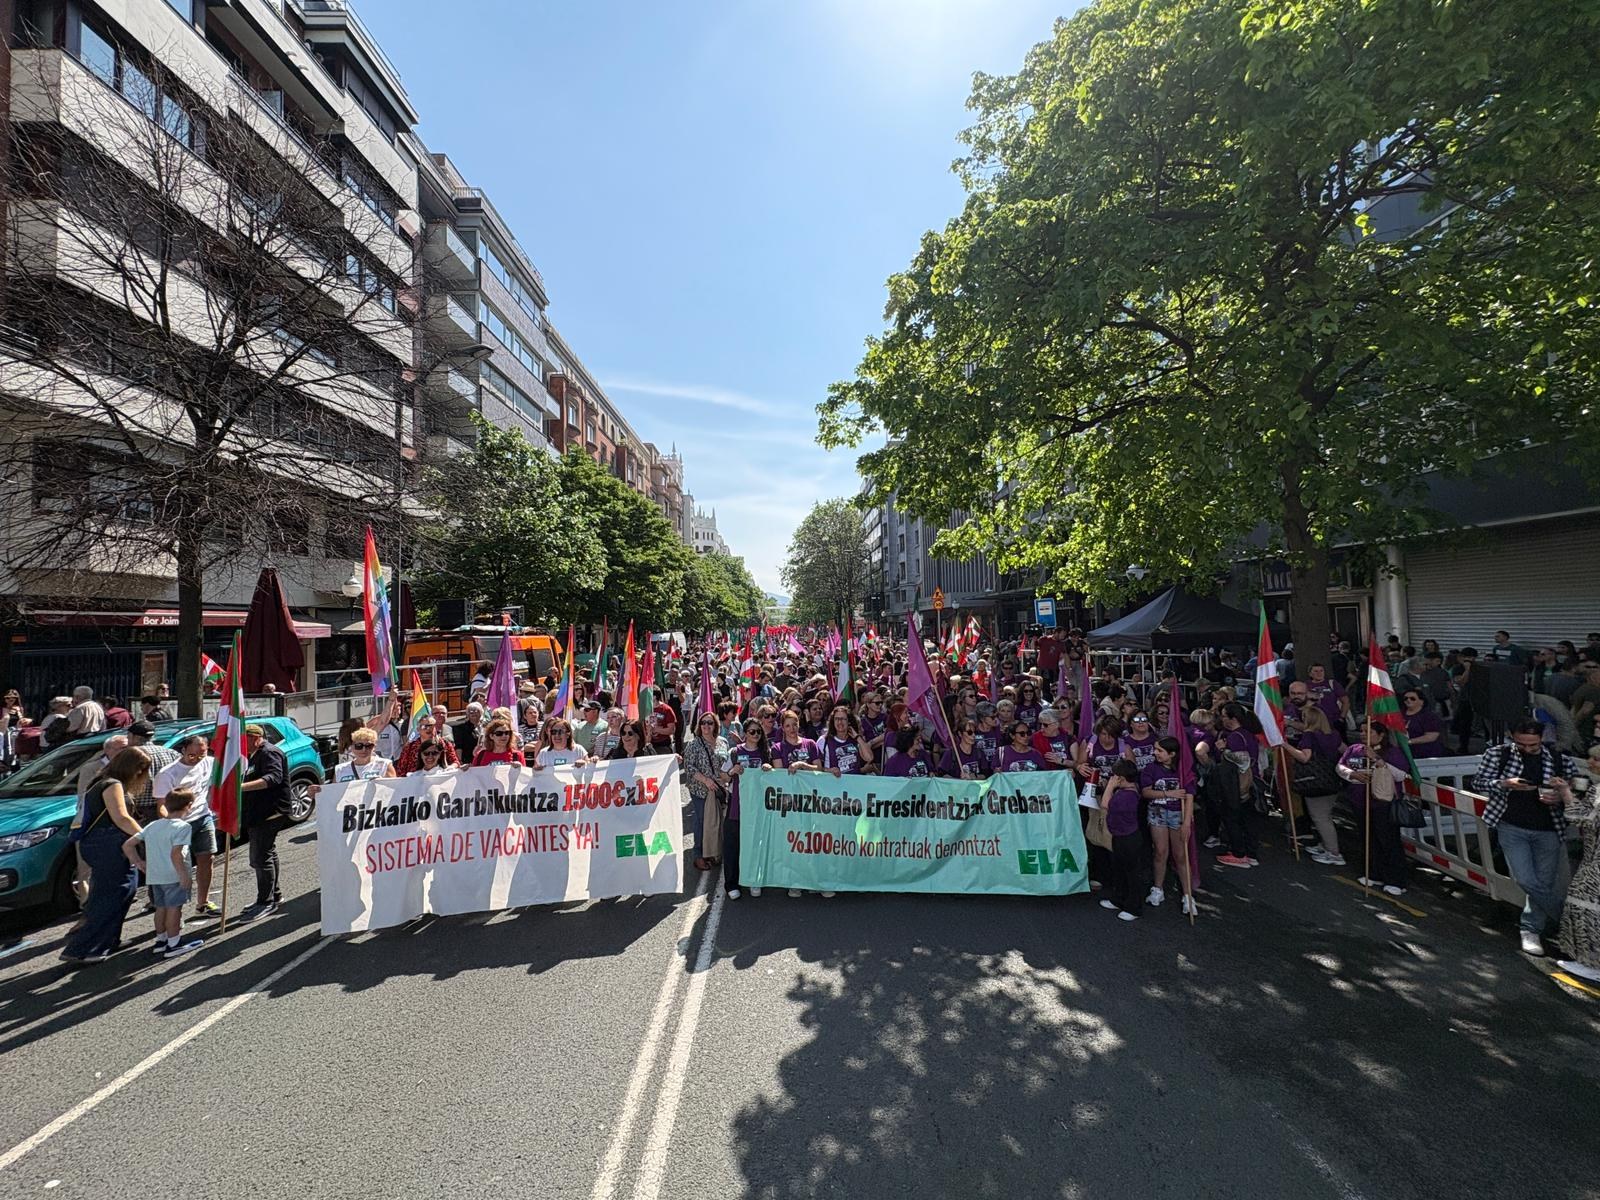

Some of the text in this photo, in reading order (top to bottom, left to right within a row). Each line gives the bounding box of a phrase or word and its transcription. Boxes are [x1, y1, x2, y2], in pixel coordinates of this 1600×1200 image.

[143, 616, 179, 625] Bar Jaim
[342, 778, 659, 833] Bizkaiko Garbikuntza 1500€x15
[764, 786, 862, 818] Gipuzkoako
[987, 789, 1053, 815] Greban
[365, 822, 600, 874] SISTEMA DE VACANTES YA!
[615, 831, 674, 858] ELA
[787, 830, 1002, 859] %100eko kontratuak denontzat
[1018, 848, 1080, 875] ELA
